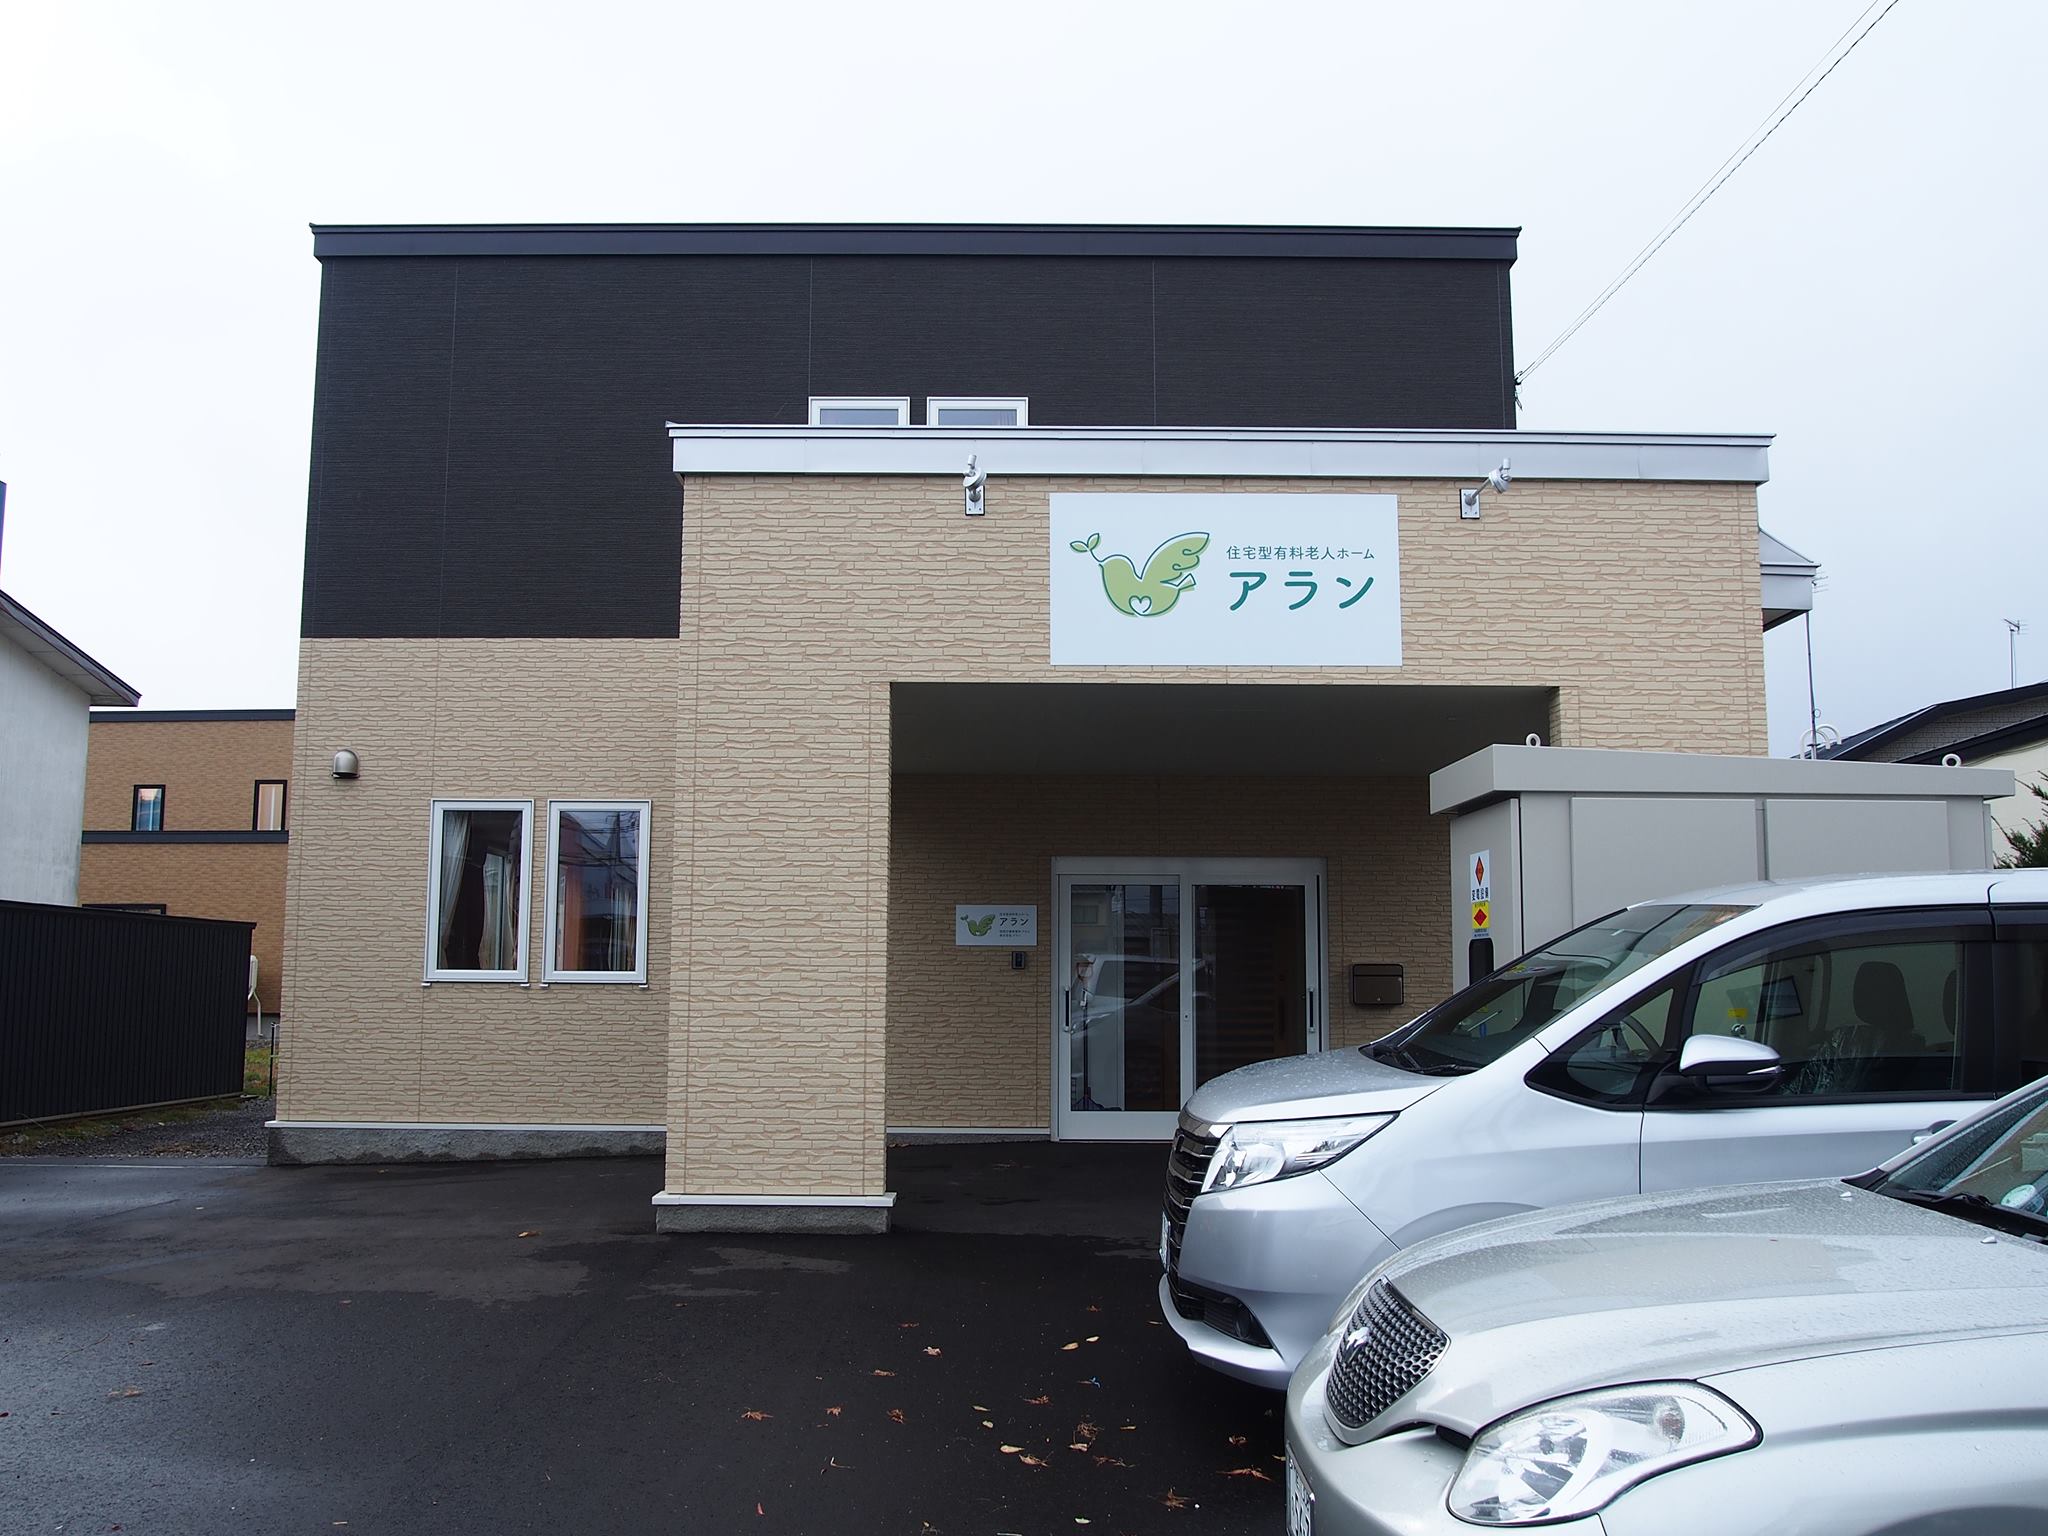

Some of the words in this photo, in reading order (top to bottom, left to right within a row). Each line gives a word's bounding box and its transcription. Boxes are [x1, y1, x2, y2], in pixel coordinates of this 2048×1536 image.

[1226, 545, 1376, 561] 住宅型有料老人ホーム
[1229, 571, 1374, 611] アラン
[999, 917, 1029, 927] アラン
